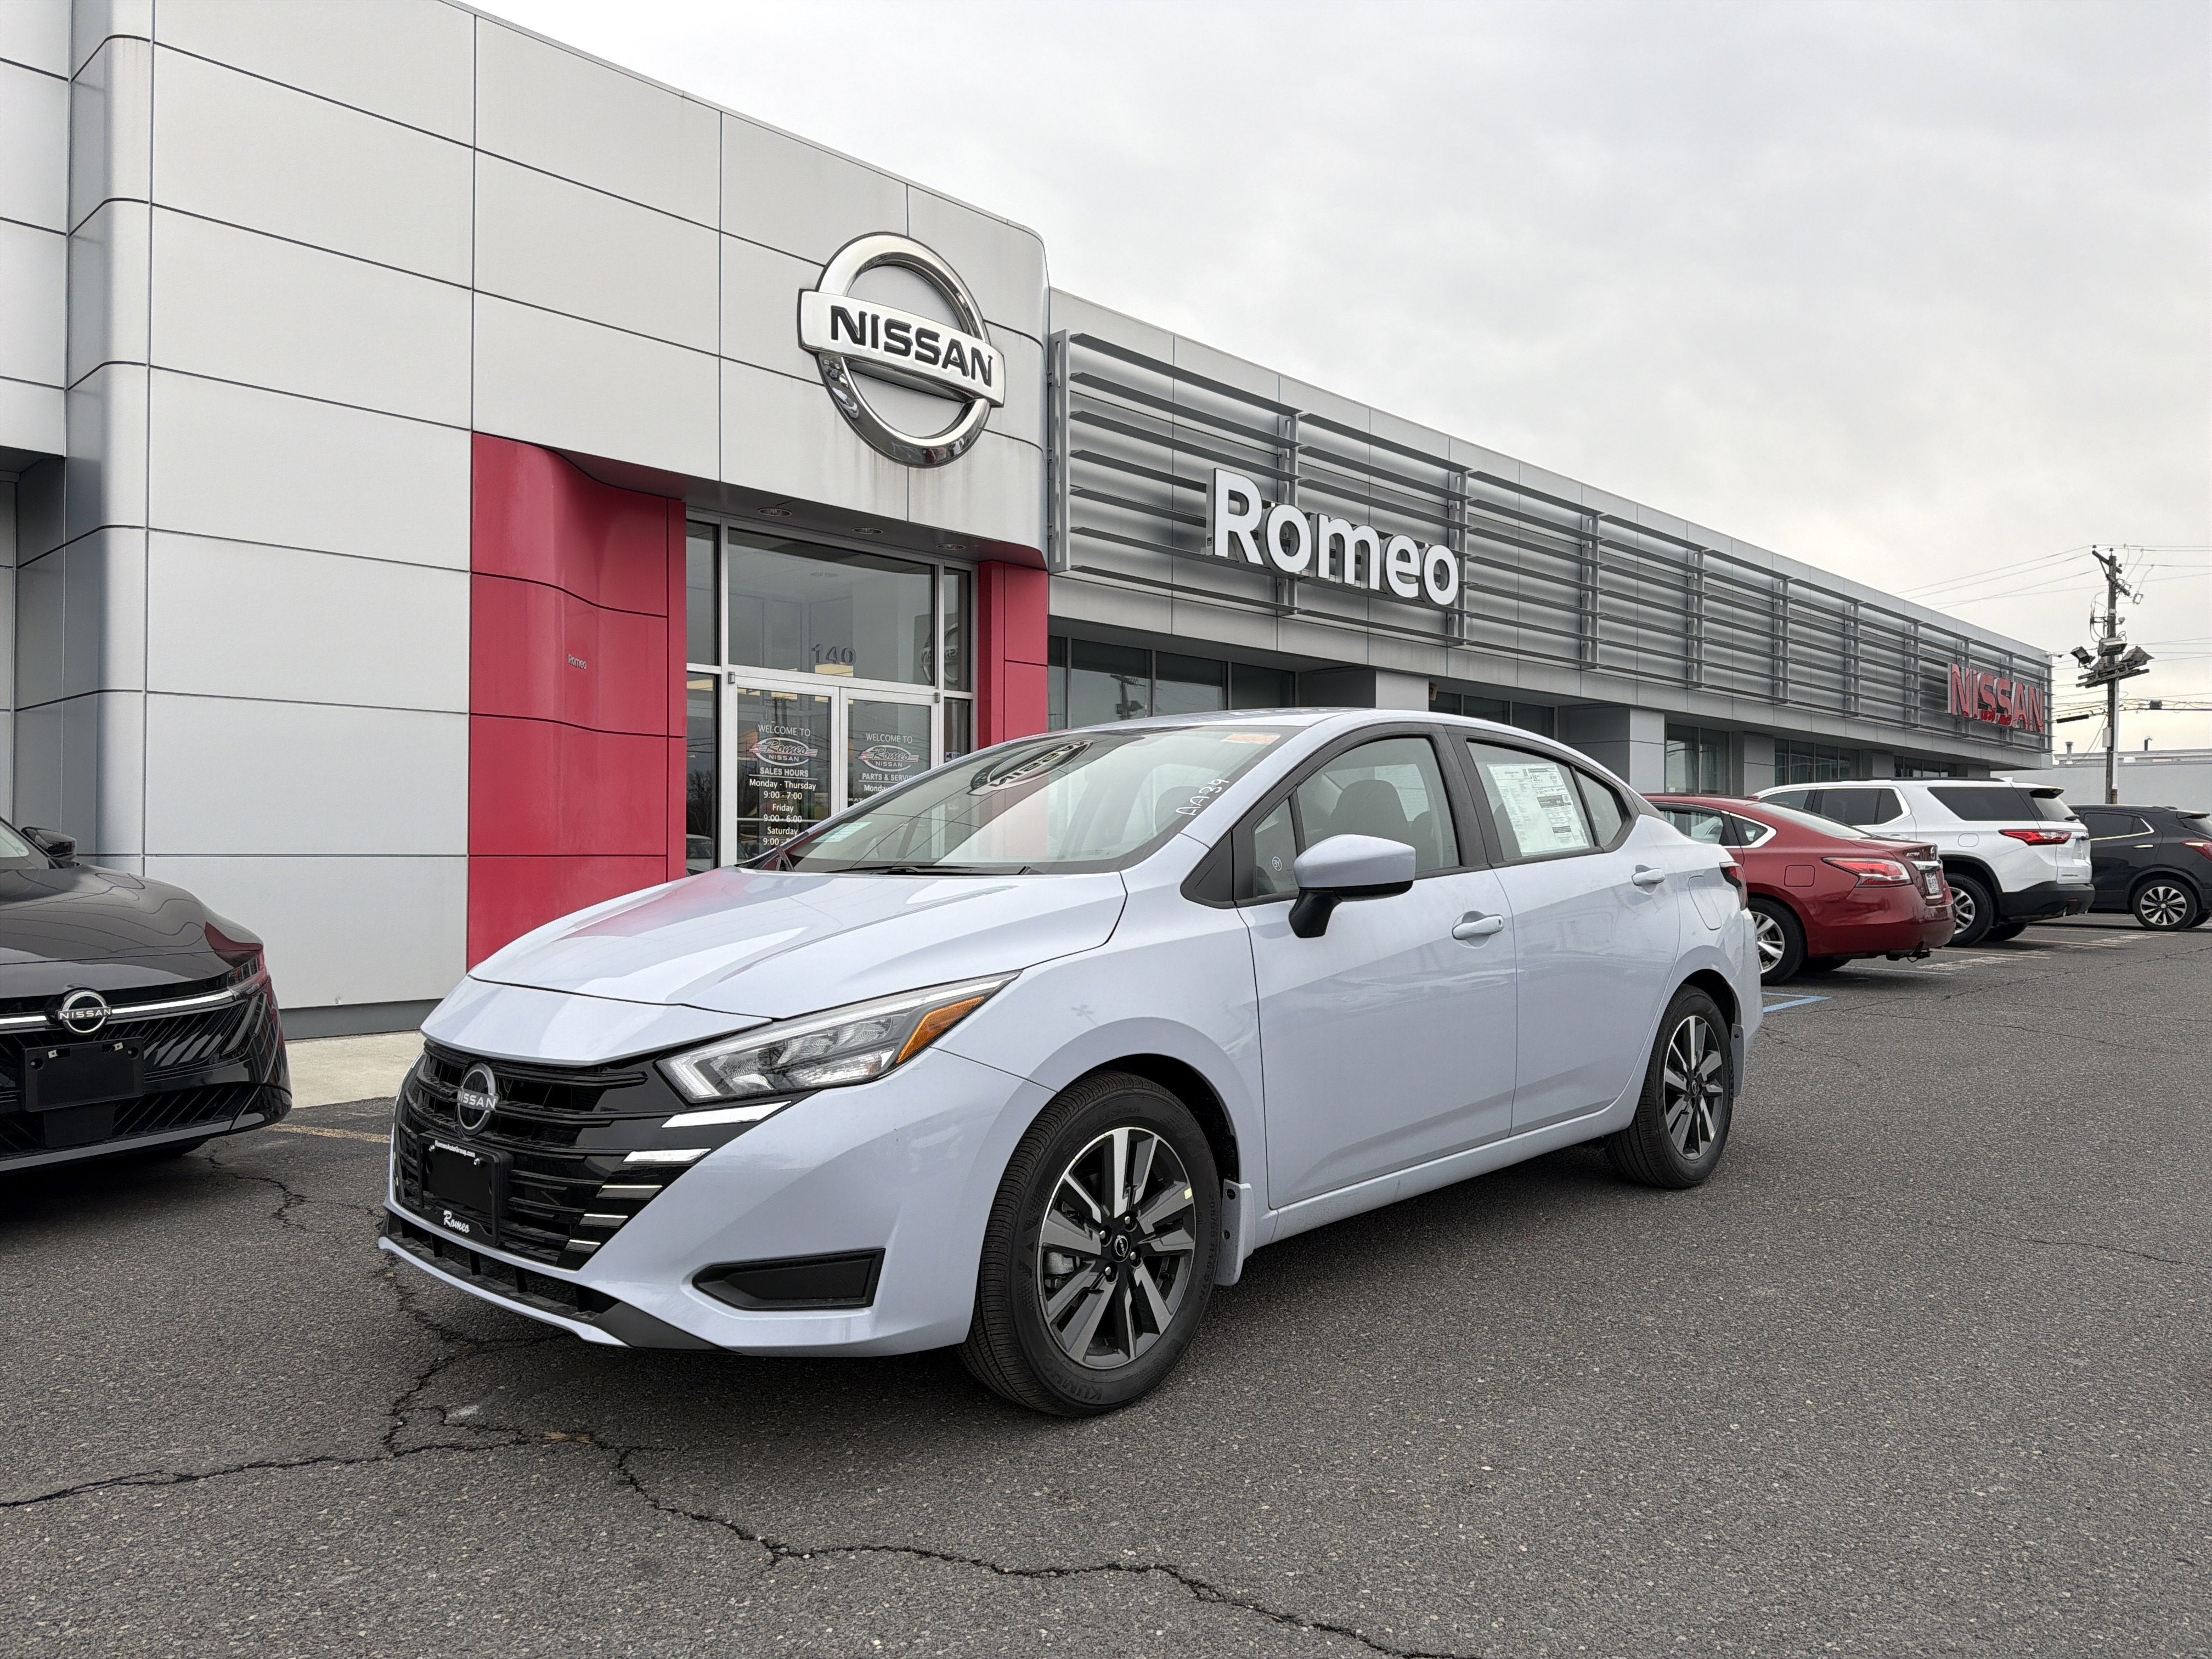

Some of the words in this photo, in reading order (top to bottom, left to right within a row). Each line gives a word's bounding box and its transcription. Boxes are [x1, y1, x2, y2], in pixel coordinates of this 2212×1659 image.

[830, 305, 993, 387] NISSAN
[1213, 467, 1460, 606] Romeo
[811, 644, 857, 665] 140
[567, 653, 587, 670] Romeo
[1951, 663, 2045, 734] NISSAN
[758, 724, 798, 736] WELCOME
[799, 728, 811, 737] TO
[865, 733, 901, 743] WELCOME
[903, 736, 913, 744] TO
[762, 738, 807, 755] Romeo
[870, 746, 910, 761] Romeo
[760, 767, 782, 775] SALES
[784, 769, 809, 777] HOURS
[862, 772, 883, 781] PARTS
[749, 778, 778, 789] Monday
[784, 780, 817, 791] Thursday
[763, 790, 780, 799] 9:00
[786, 792, 803, 800] 7:00
[1176, 778, 1230, 816] AA39
[772, 803, 794, 812] Friday
[763, 814, 780, 822] 9:00
[786, 815, 802, 823] 6:00
[767, 826, 798, 836] Saturday
[763, 837, 780, 845] 9:00
[59, 1008, 111, 1019] NISSAN
[457, 1090, 496, 1109] NISSAN
[443, 1210, 470, 1233] Romeo
